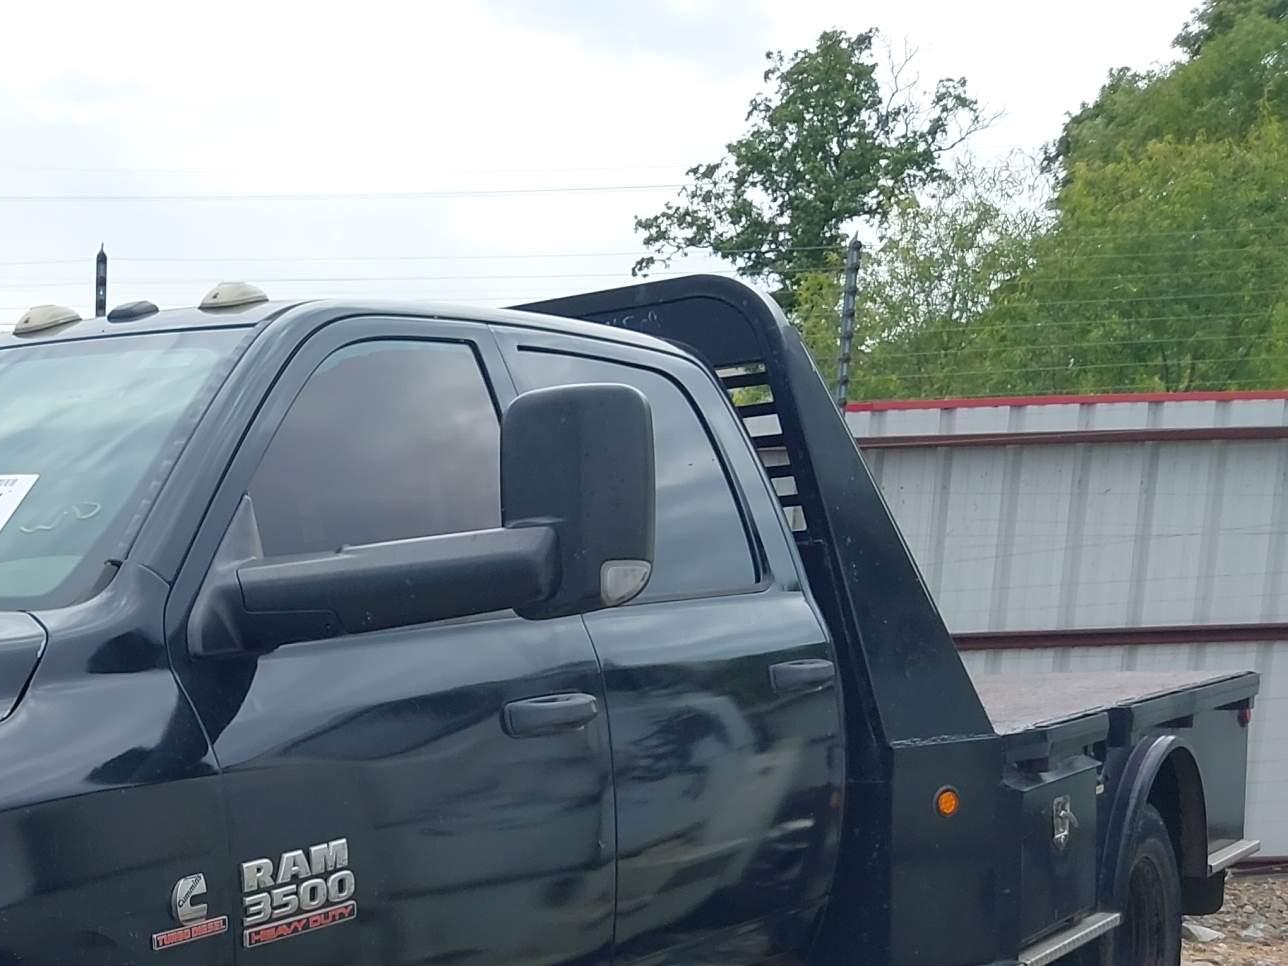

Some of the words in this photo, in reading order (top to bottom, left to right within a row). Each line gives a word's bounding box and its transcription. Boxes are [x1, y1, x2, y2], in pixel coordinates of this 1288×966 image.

[242, 838, 348, 893] RAM
[243, 869, 355, 927] 3500
[156, 928, 191, 947] TURBO
[191, 919, 226, 938] DIESEL
[250, 918, 307, 944] HEAVY
[308, 904, 353, 928] DUTY
